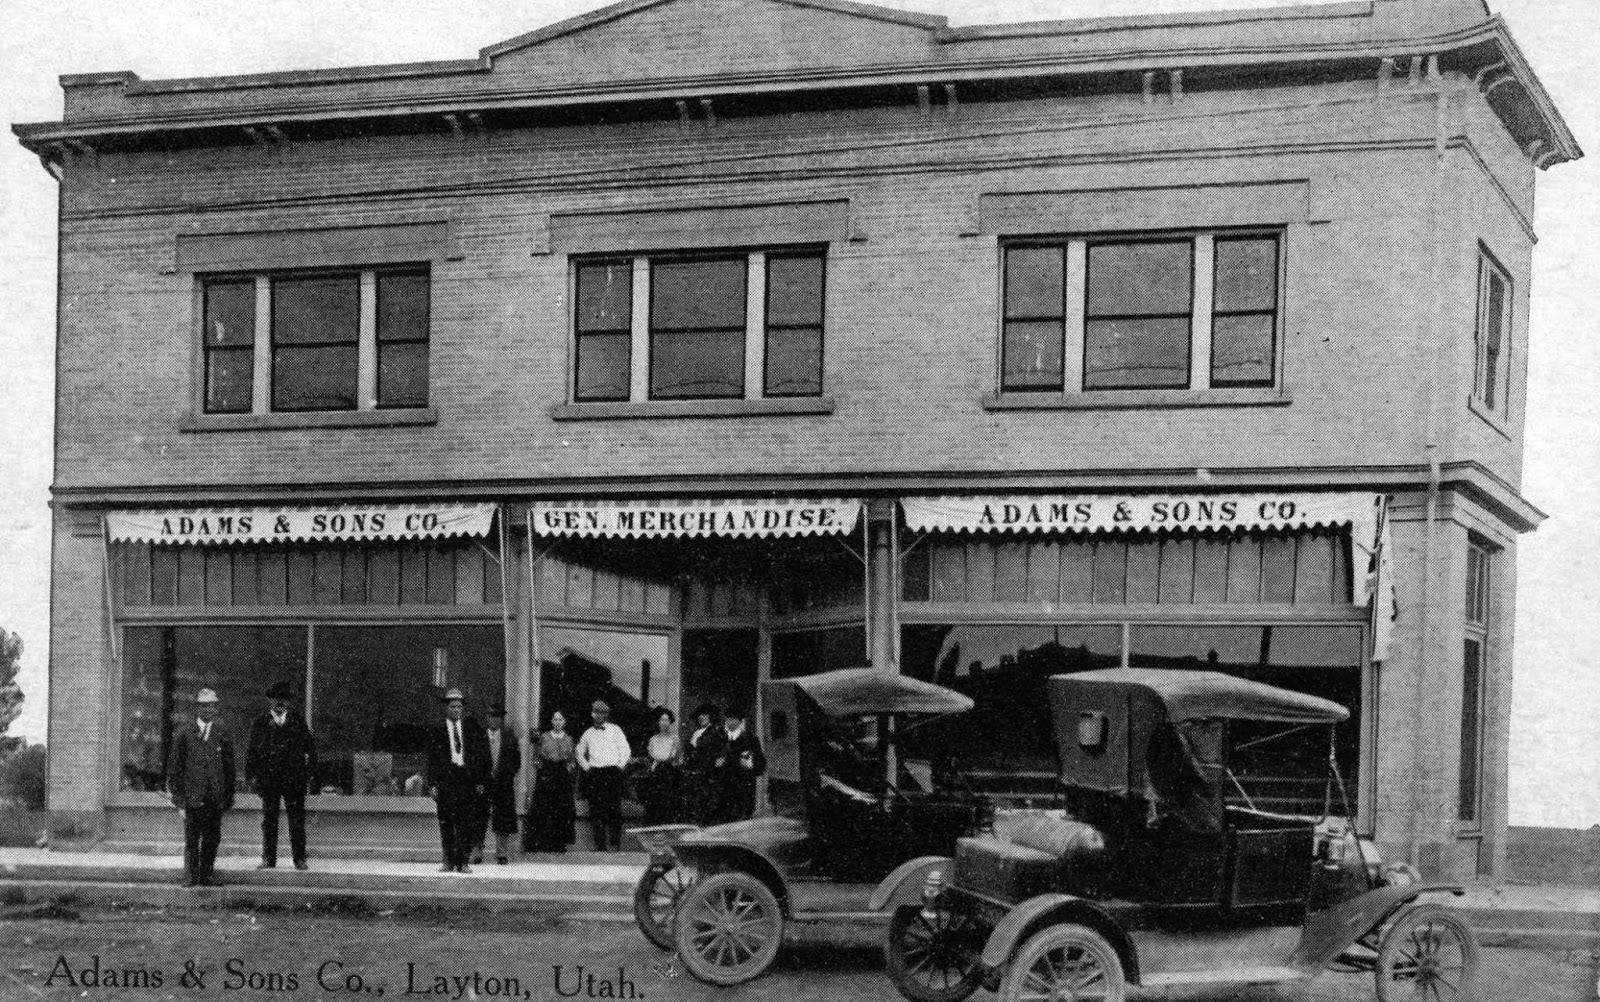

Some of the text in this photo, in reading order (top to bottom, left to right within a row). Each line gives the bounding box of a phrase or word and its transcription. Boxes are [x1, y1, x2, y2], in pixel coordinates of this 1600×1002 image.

[161, 512, 447, 536] ADAMS & SONS CO.
[544, 507, 843, 530] GEN. MERCHANDISE.
[978, 501, 1306, 525] ADAMS & SONS CO.
